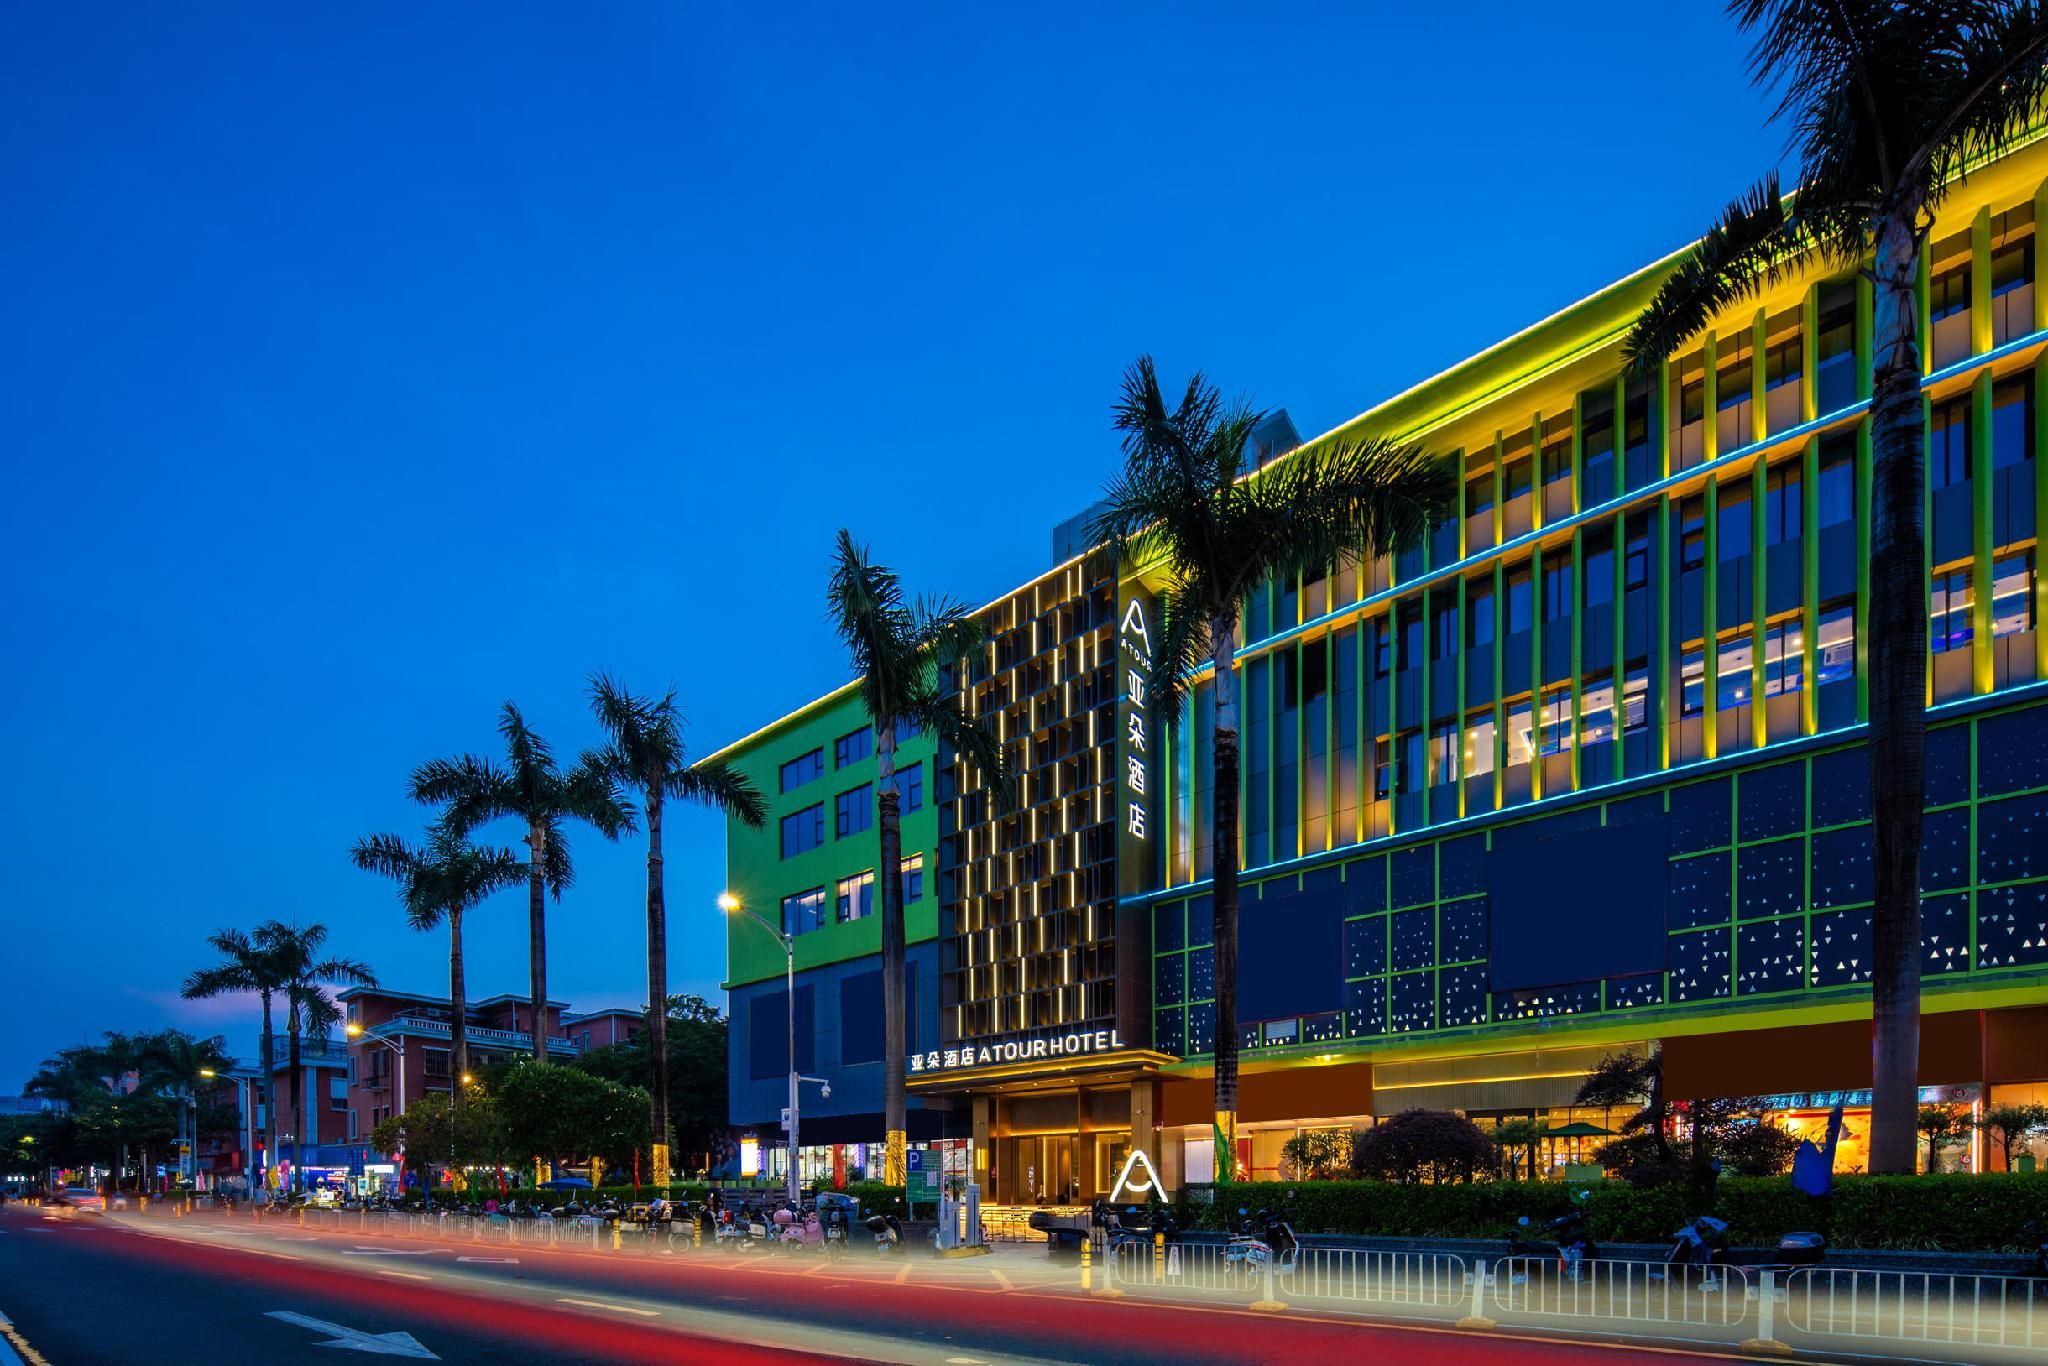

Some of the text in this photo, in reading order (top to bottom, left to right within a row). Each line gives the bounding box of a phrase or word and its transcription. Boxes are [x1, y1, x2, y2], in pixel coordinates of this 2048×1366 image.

[1128, 669, 1146, 840] 亚朵酒店
[911, 1029, 1125, 1071] 亚朵酒店 ATOUR HOTEL
[909, 1151, 919, 1169] P
